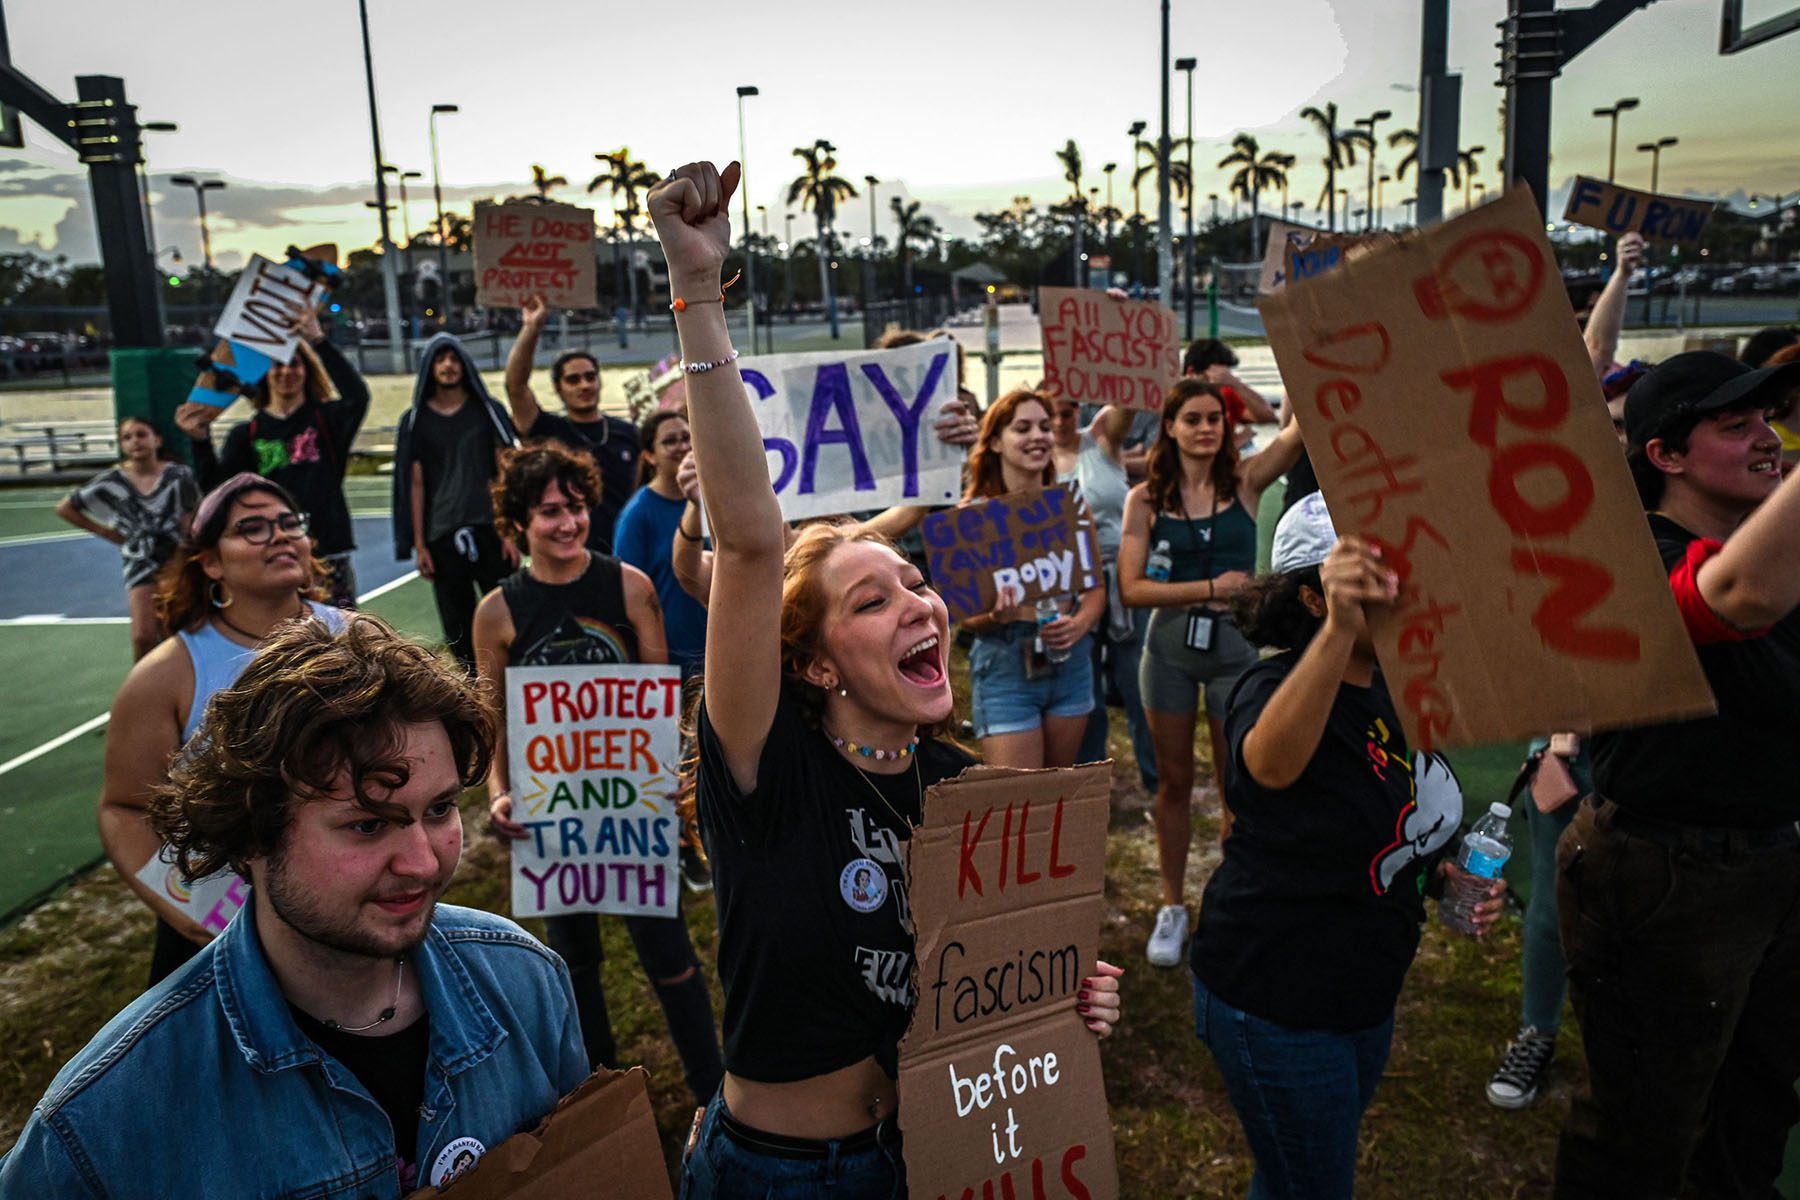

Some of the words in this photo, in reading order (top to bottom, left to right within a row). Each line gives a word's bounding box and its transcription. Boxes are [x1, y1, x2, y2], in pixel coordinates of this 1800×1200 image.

[486, 214, 524, 238] HE
[530, 216, 590, 242] DOES
[500, 241, 569, 262] NOT
[482, 266, 581, 291] PROTECT
[232, 262, 316, 345] VOTE
[1117, 302, 1172, 344] YOU
[1044, 324, 1179, 378] FASCISTS
[1043, 363, 1136, 406] BOUND
[1440, 352, 1640, 664] RON
[523, 677, 682, 725] PROTECT
[526, 728, 659, 775] QUEER
[547, 777, 638, 814] AND
[522, 816, 671, 860] TRANS
[958, 796, 1077, 899] KILL
[520, 862, 666, 912] YOUTH
[932, 941, 1079, 1031] fascism
[949, 1043, 1060, 1118] before
[991, 1108, 1023, 1164] it
